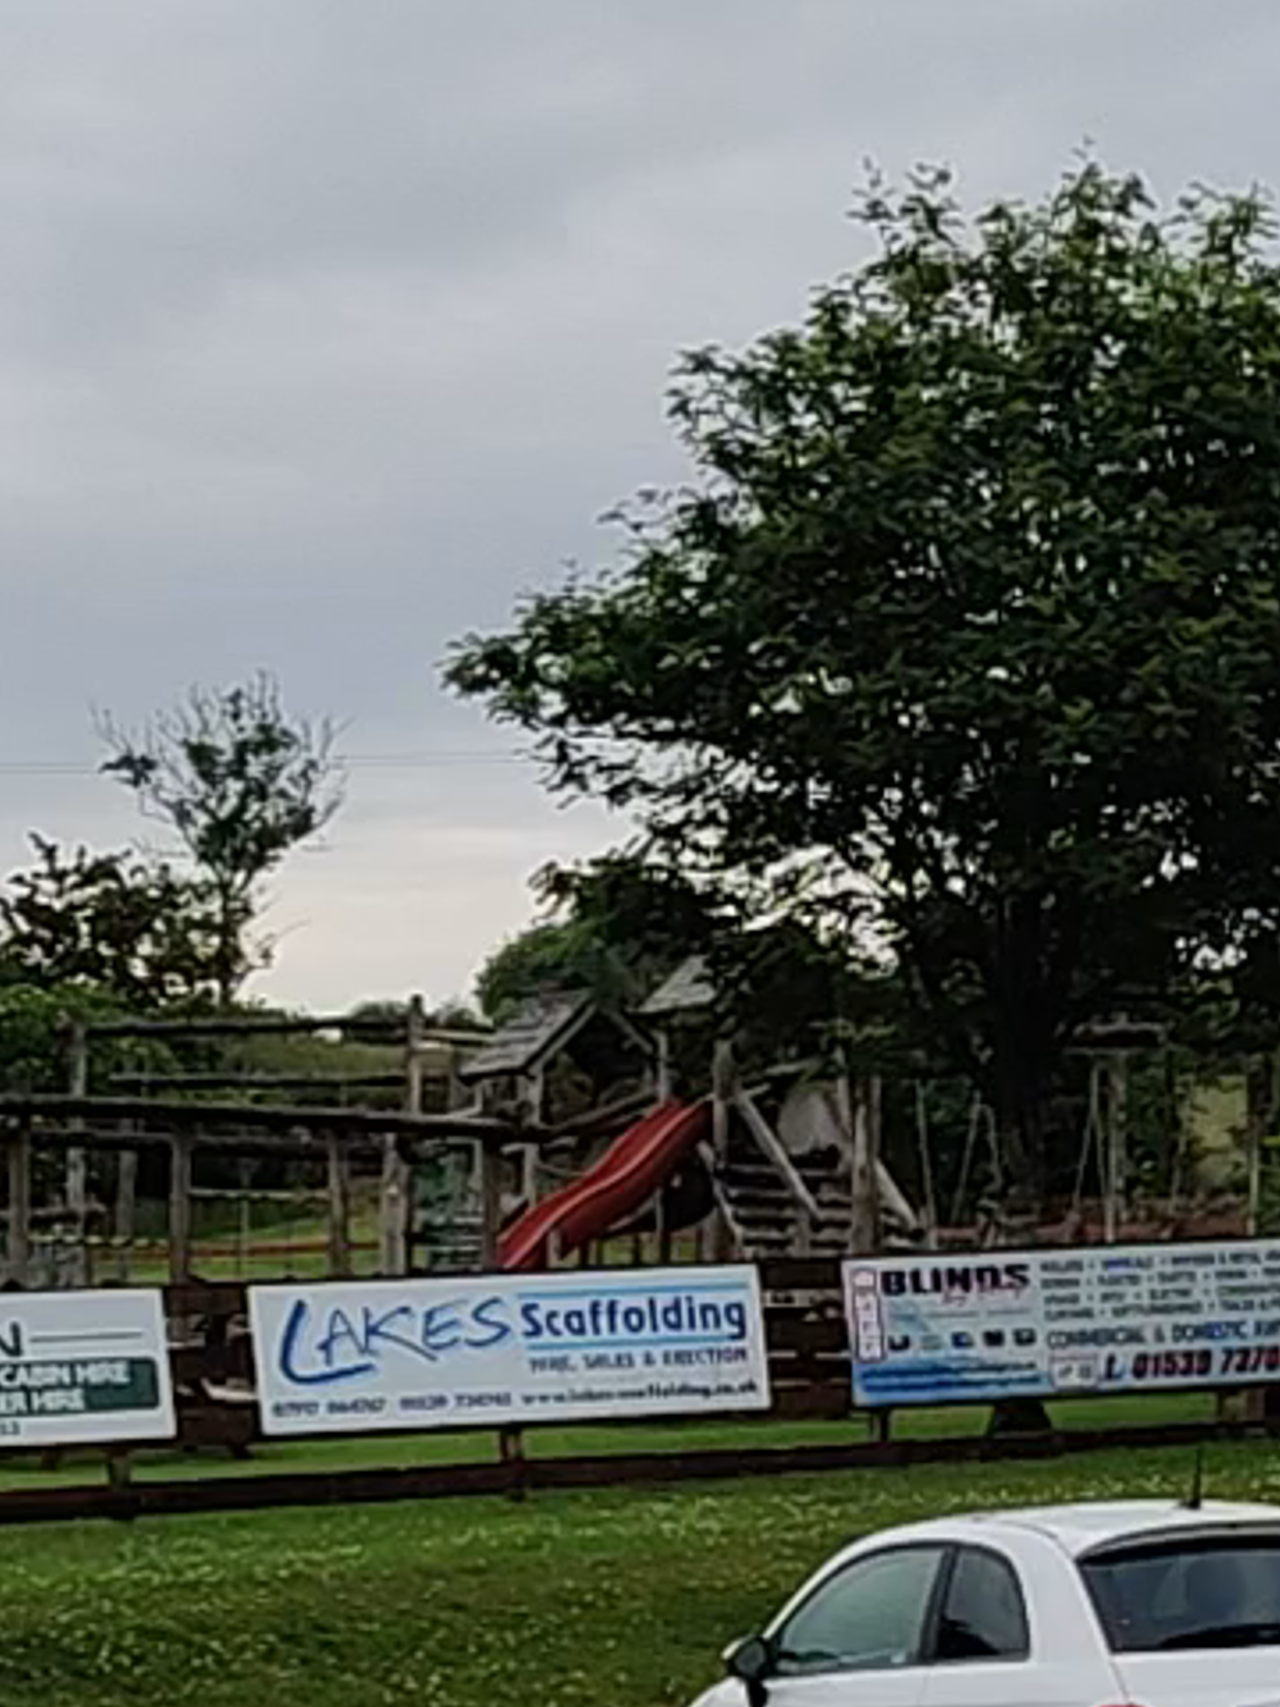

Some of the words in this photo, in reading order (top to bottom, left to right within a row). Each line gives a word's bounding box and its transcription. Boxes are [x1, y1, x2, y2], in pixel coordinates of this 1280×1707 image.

[881, 1264, 1030, 1296] BLINDS
[280, 1297, 511, 1384] LAKES
[521, 1297, 747, 1340] Scaffolding
[662, 1347, 748, 1366] ERECTION
[76, 1361, 130, 1385] HIRE
[32, 1388, 85, 1411] HIRE
